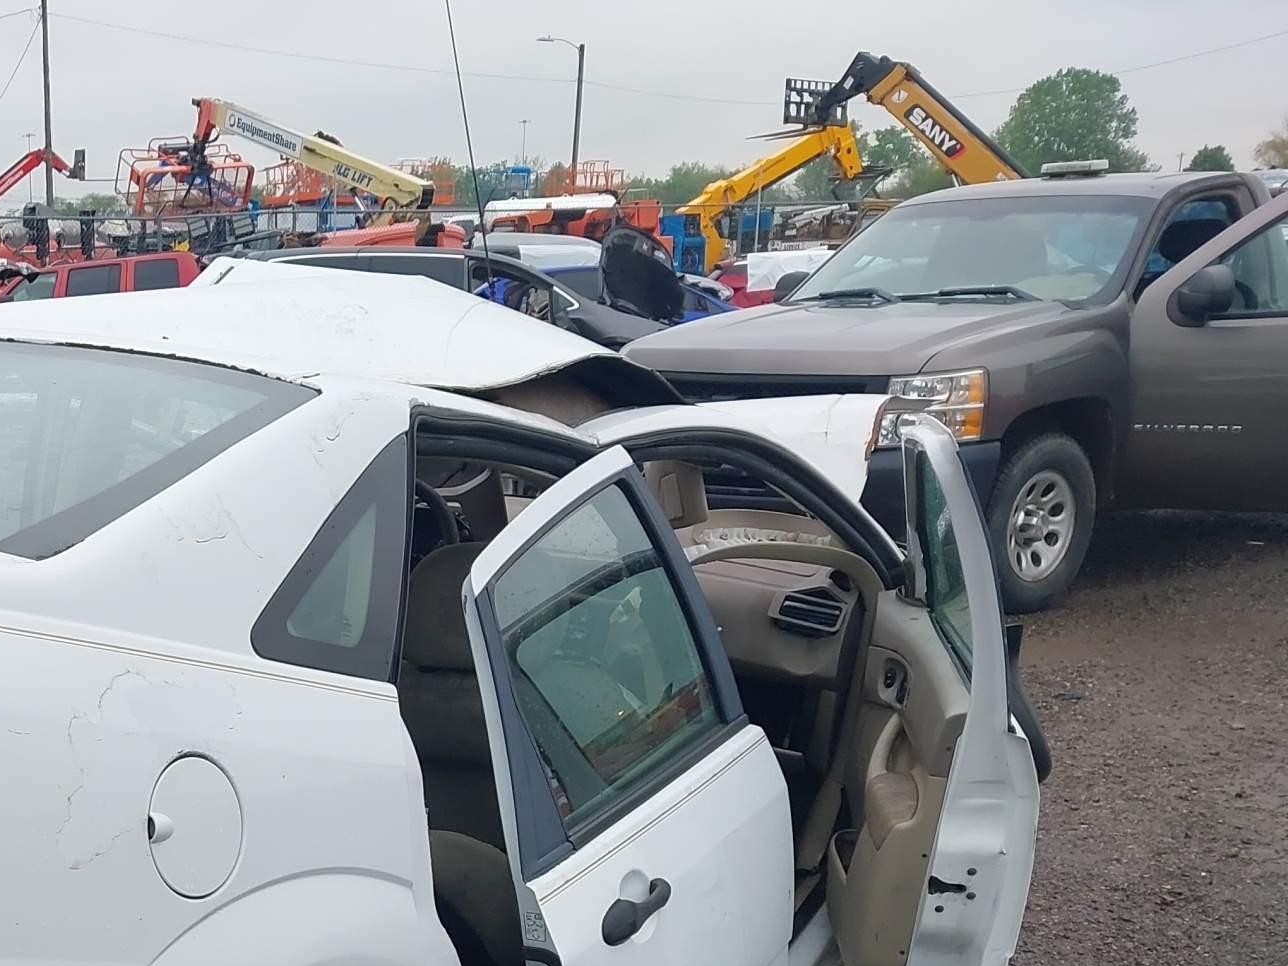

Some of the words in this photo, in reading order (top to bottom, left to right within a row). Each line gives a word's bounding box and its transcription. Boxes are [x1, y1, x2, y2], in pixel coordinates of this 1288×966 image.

[237, 116, 297, 152] EquipmentShare
[908, 107, 958, 152] SANY
[350, 170, 374, 188] LIFT
